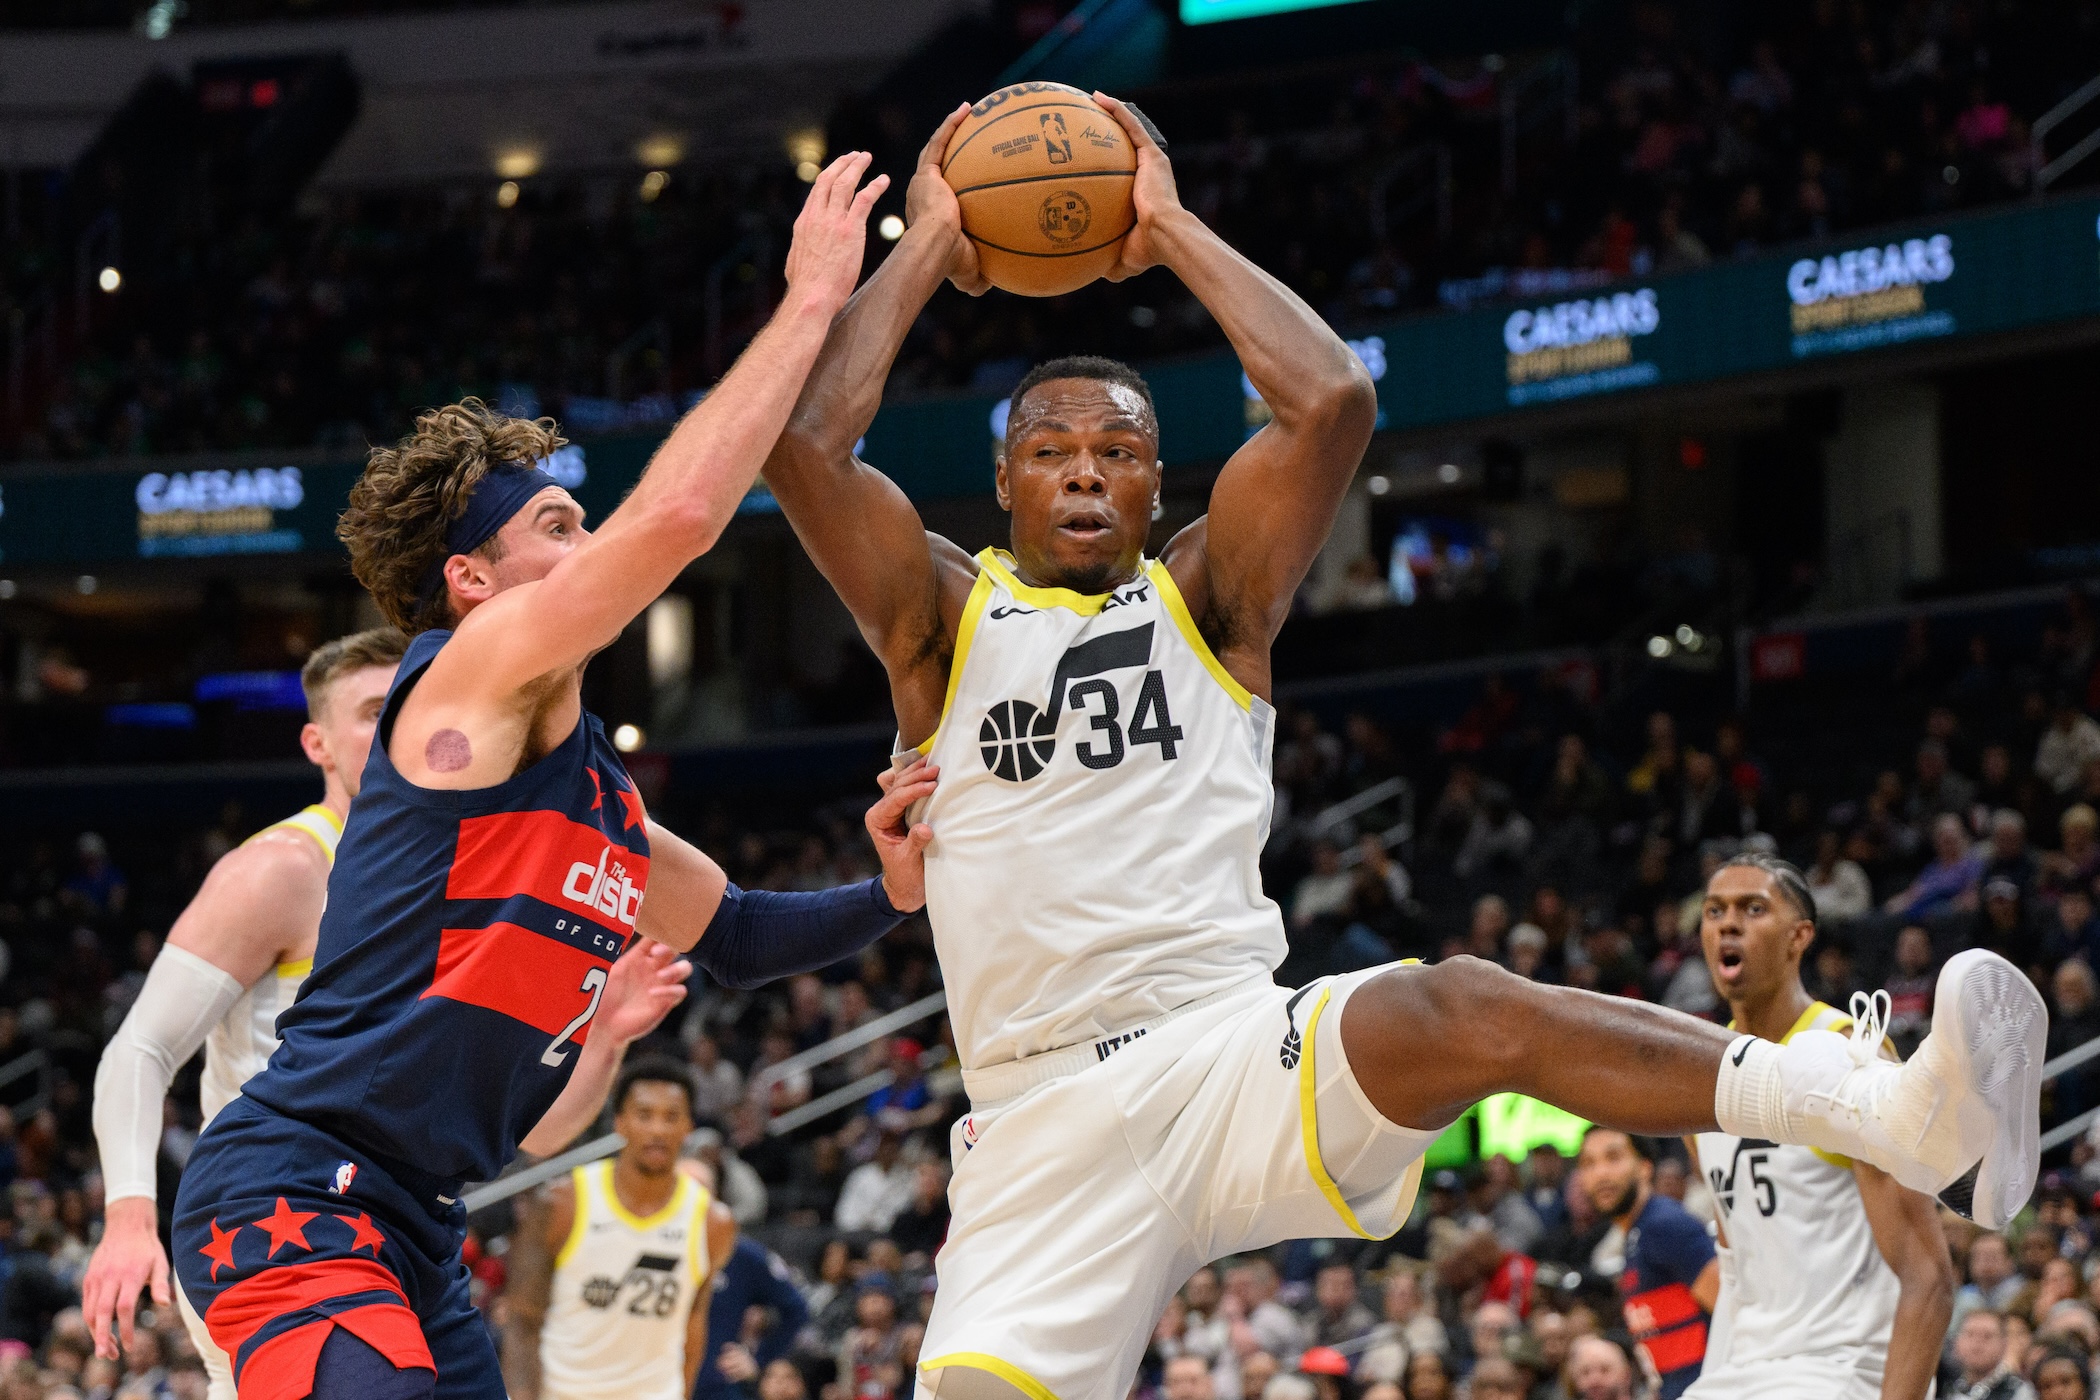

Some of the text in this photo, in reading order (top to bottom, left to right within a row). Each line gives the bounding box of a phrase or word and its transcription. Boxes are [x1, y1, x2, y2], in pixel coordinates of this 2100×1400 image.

[1787, 234, 1955, 306] CAESARS
[1504, 288, 1660, 355] CAESARS
[136, 466, 304, 514] CAESARS
[1069, 669, 1184, 770] 34
[555, 918, 622, 956] OF CO
[1751, 1154, 1777, 1217] 5
